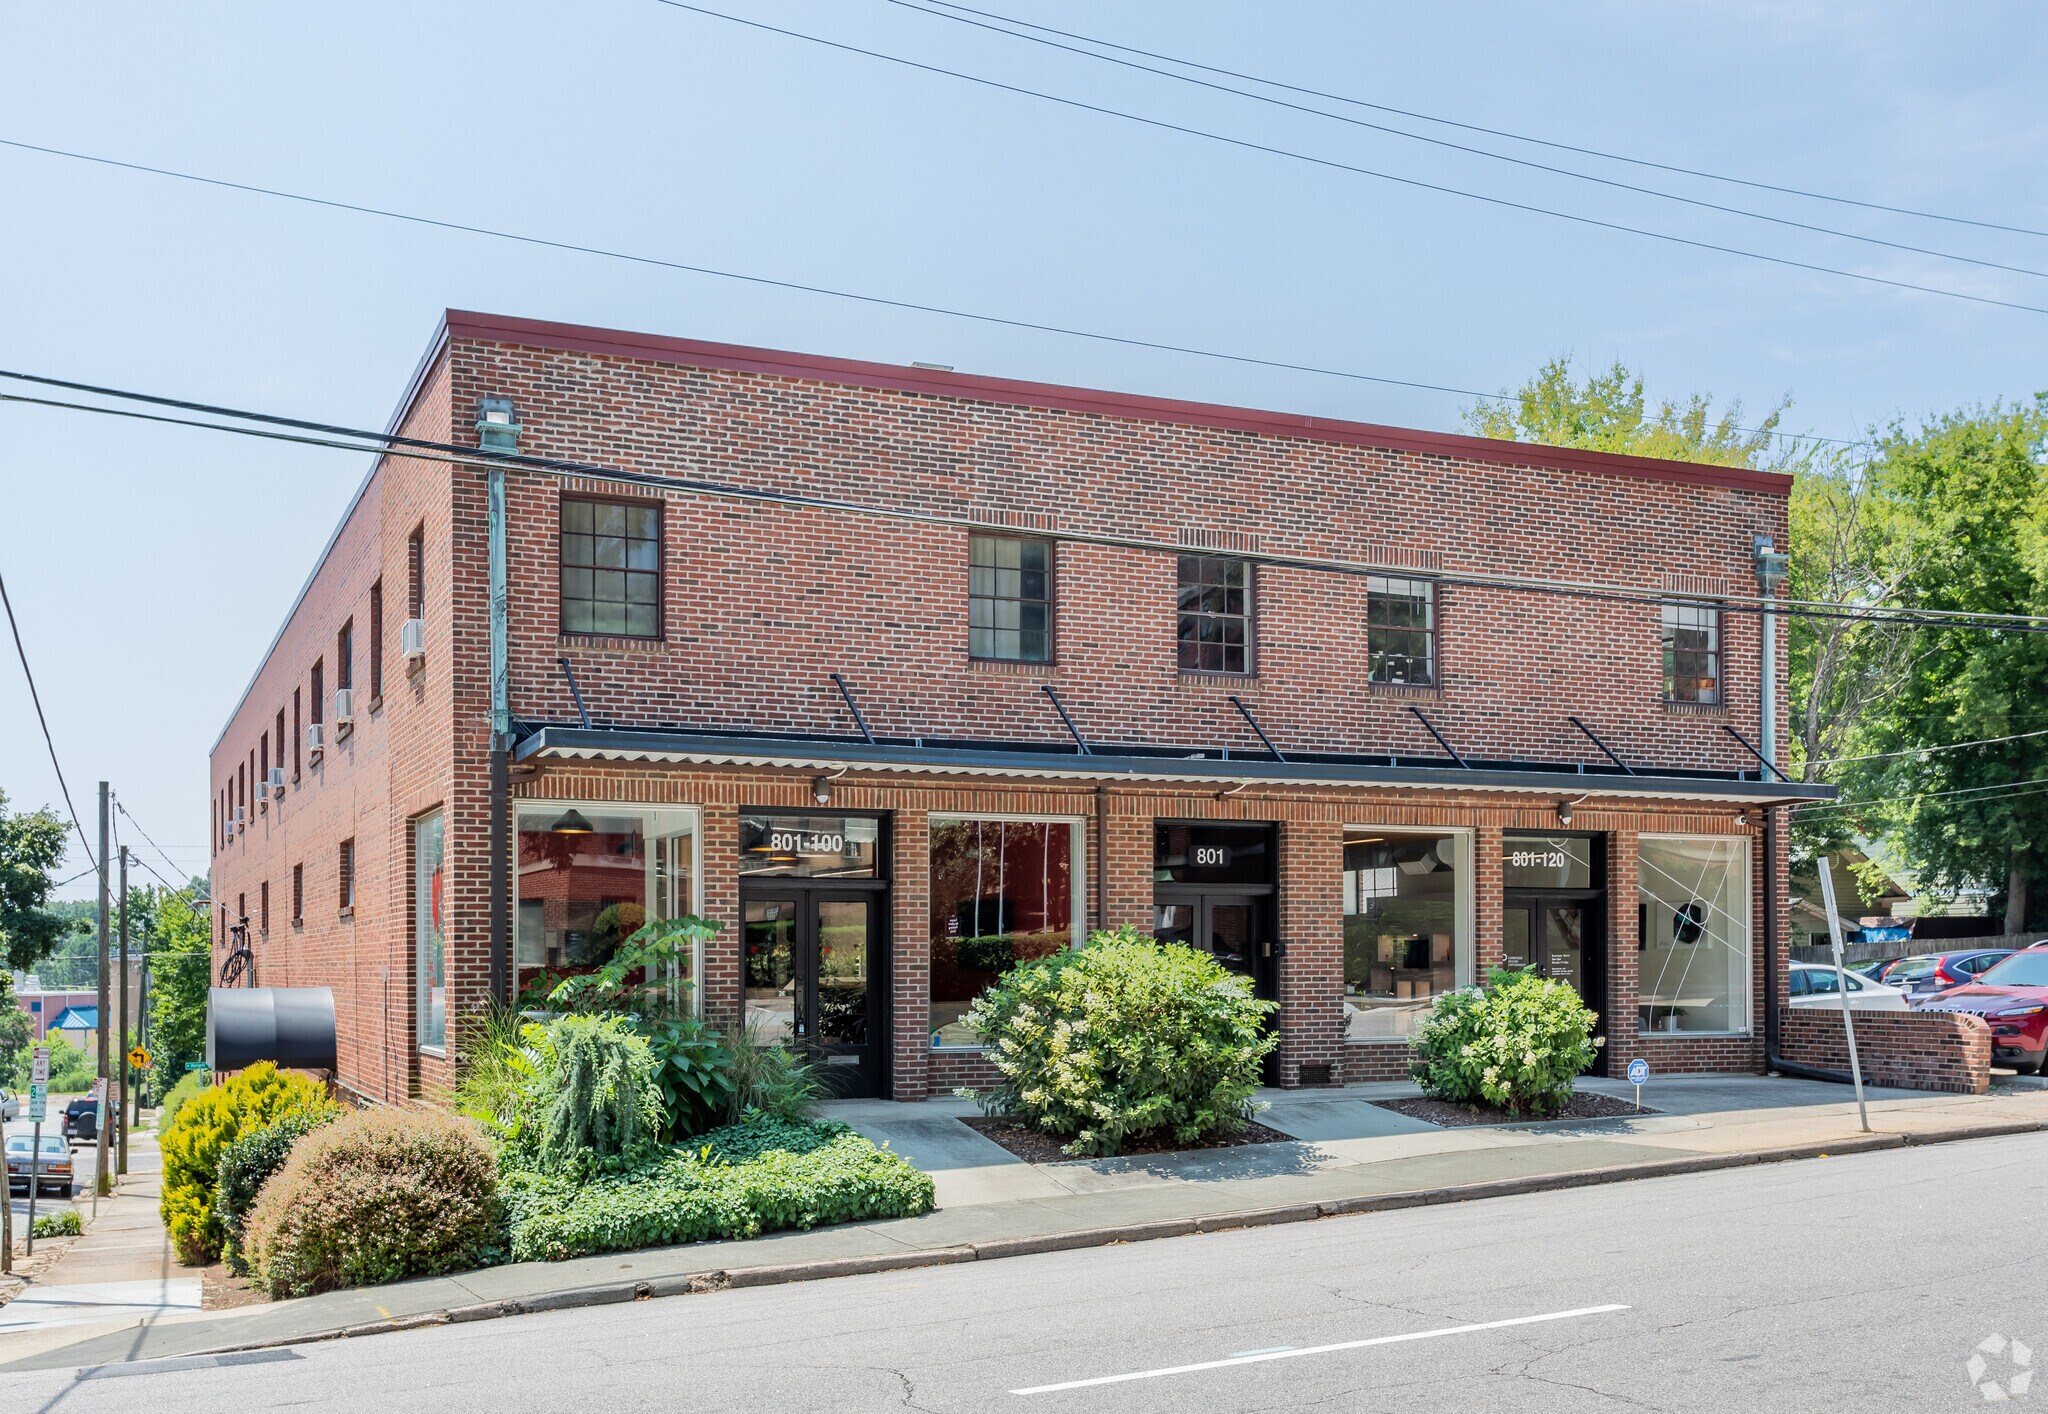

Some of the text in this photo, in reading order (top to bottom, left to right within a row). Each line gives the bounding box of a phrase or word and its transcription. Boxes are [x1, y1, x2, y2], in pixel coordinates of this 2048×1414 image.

[771, 833, 843, 852] 801-100
[1196, 848, 1223, 864] 801
[1512, 851, 1565, 868] 801-120
[35, 1068, 46, 1076] TIME
[1630, 1066, 1647, 1077] ADT
[31, 1086, 36, 1098] 2
